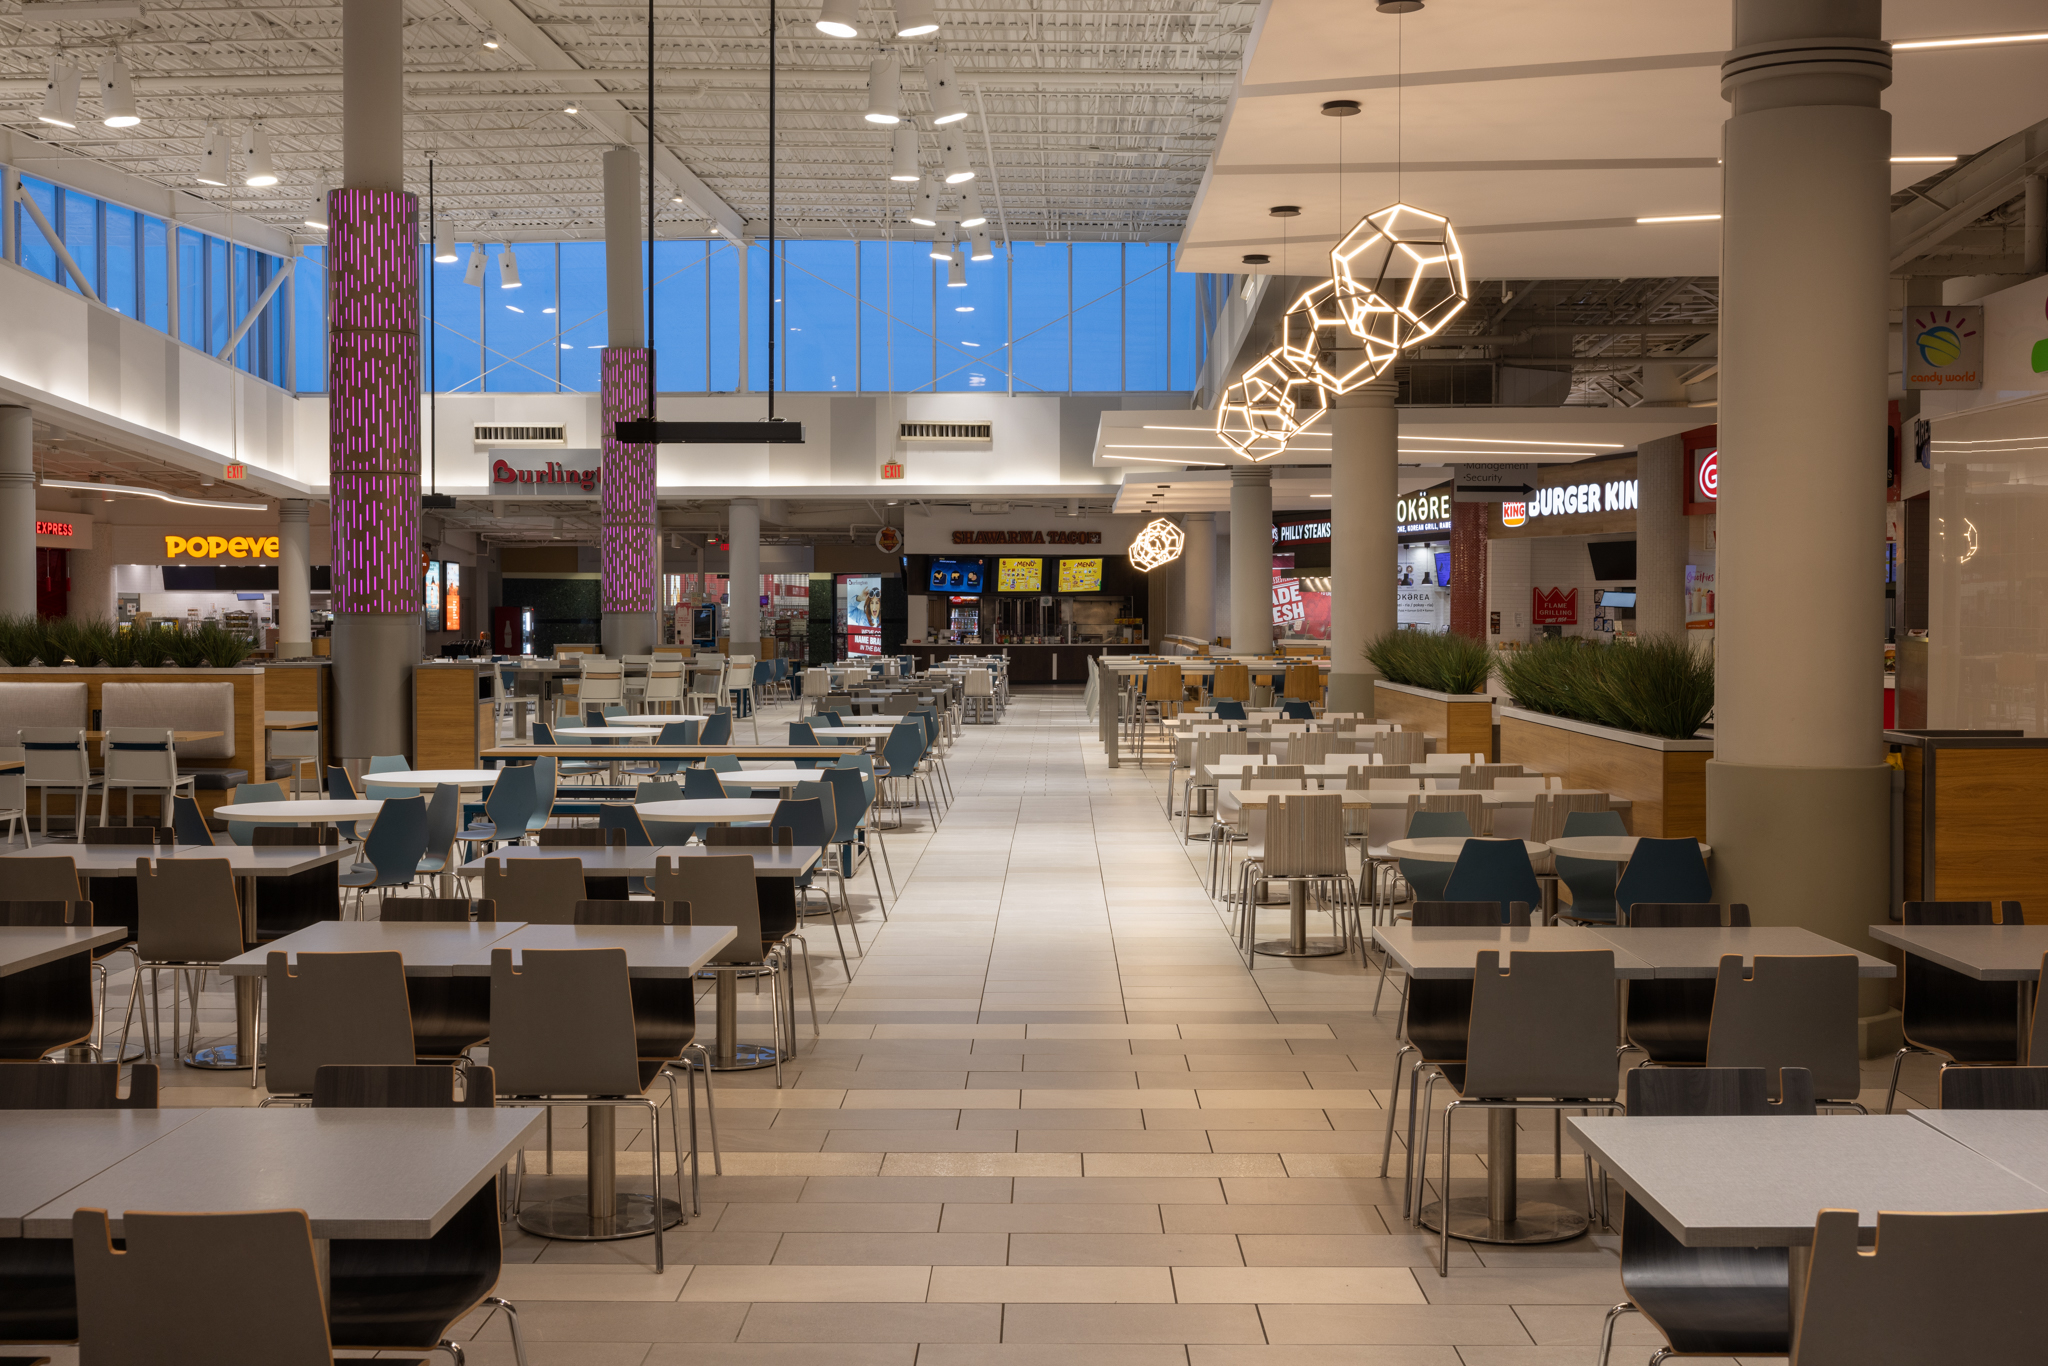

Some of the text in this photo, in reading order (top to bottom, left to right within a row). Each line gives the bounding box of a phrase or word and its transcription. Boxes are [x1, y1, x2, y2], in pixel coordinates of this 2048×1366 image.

[1911, 371, 1976, 386] candy world
[227, 466, 244, 478] EXIT
[884, 464, 901, 478] EXIT
[1466, 474, 1502, 483] Security
[1528, 480, 1638, 517] BURGER KIN
[1504, 504, 1525, 518] KING
[36, 521, 73, 536] EXPRESS
[1280, 522, 1331, 540] PHILLY STEAKS
[952, 530, 1046, 544] SHAWARMA
[854, 635, 869, 644] NAME
